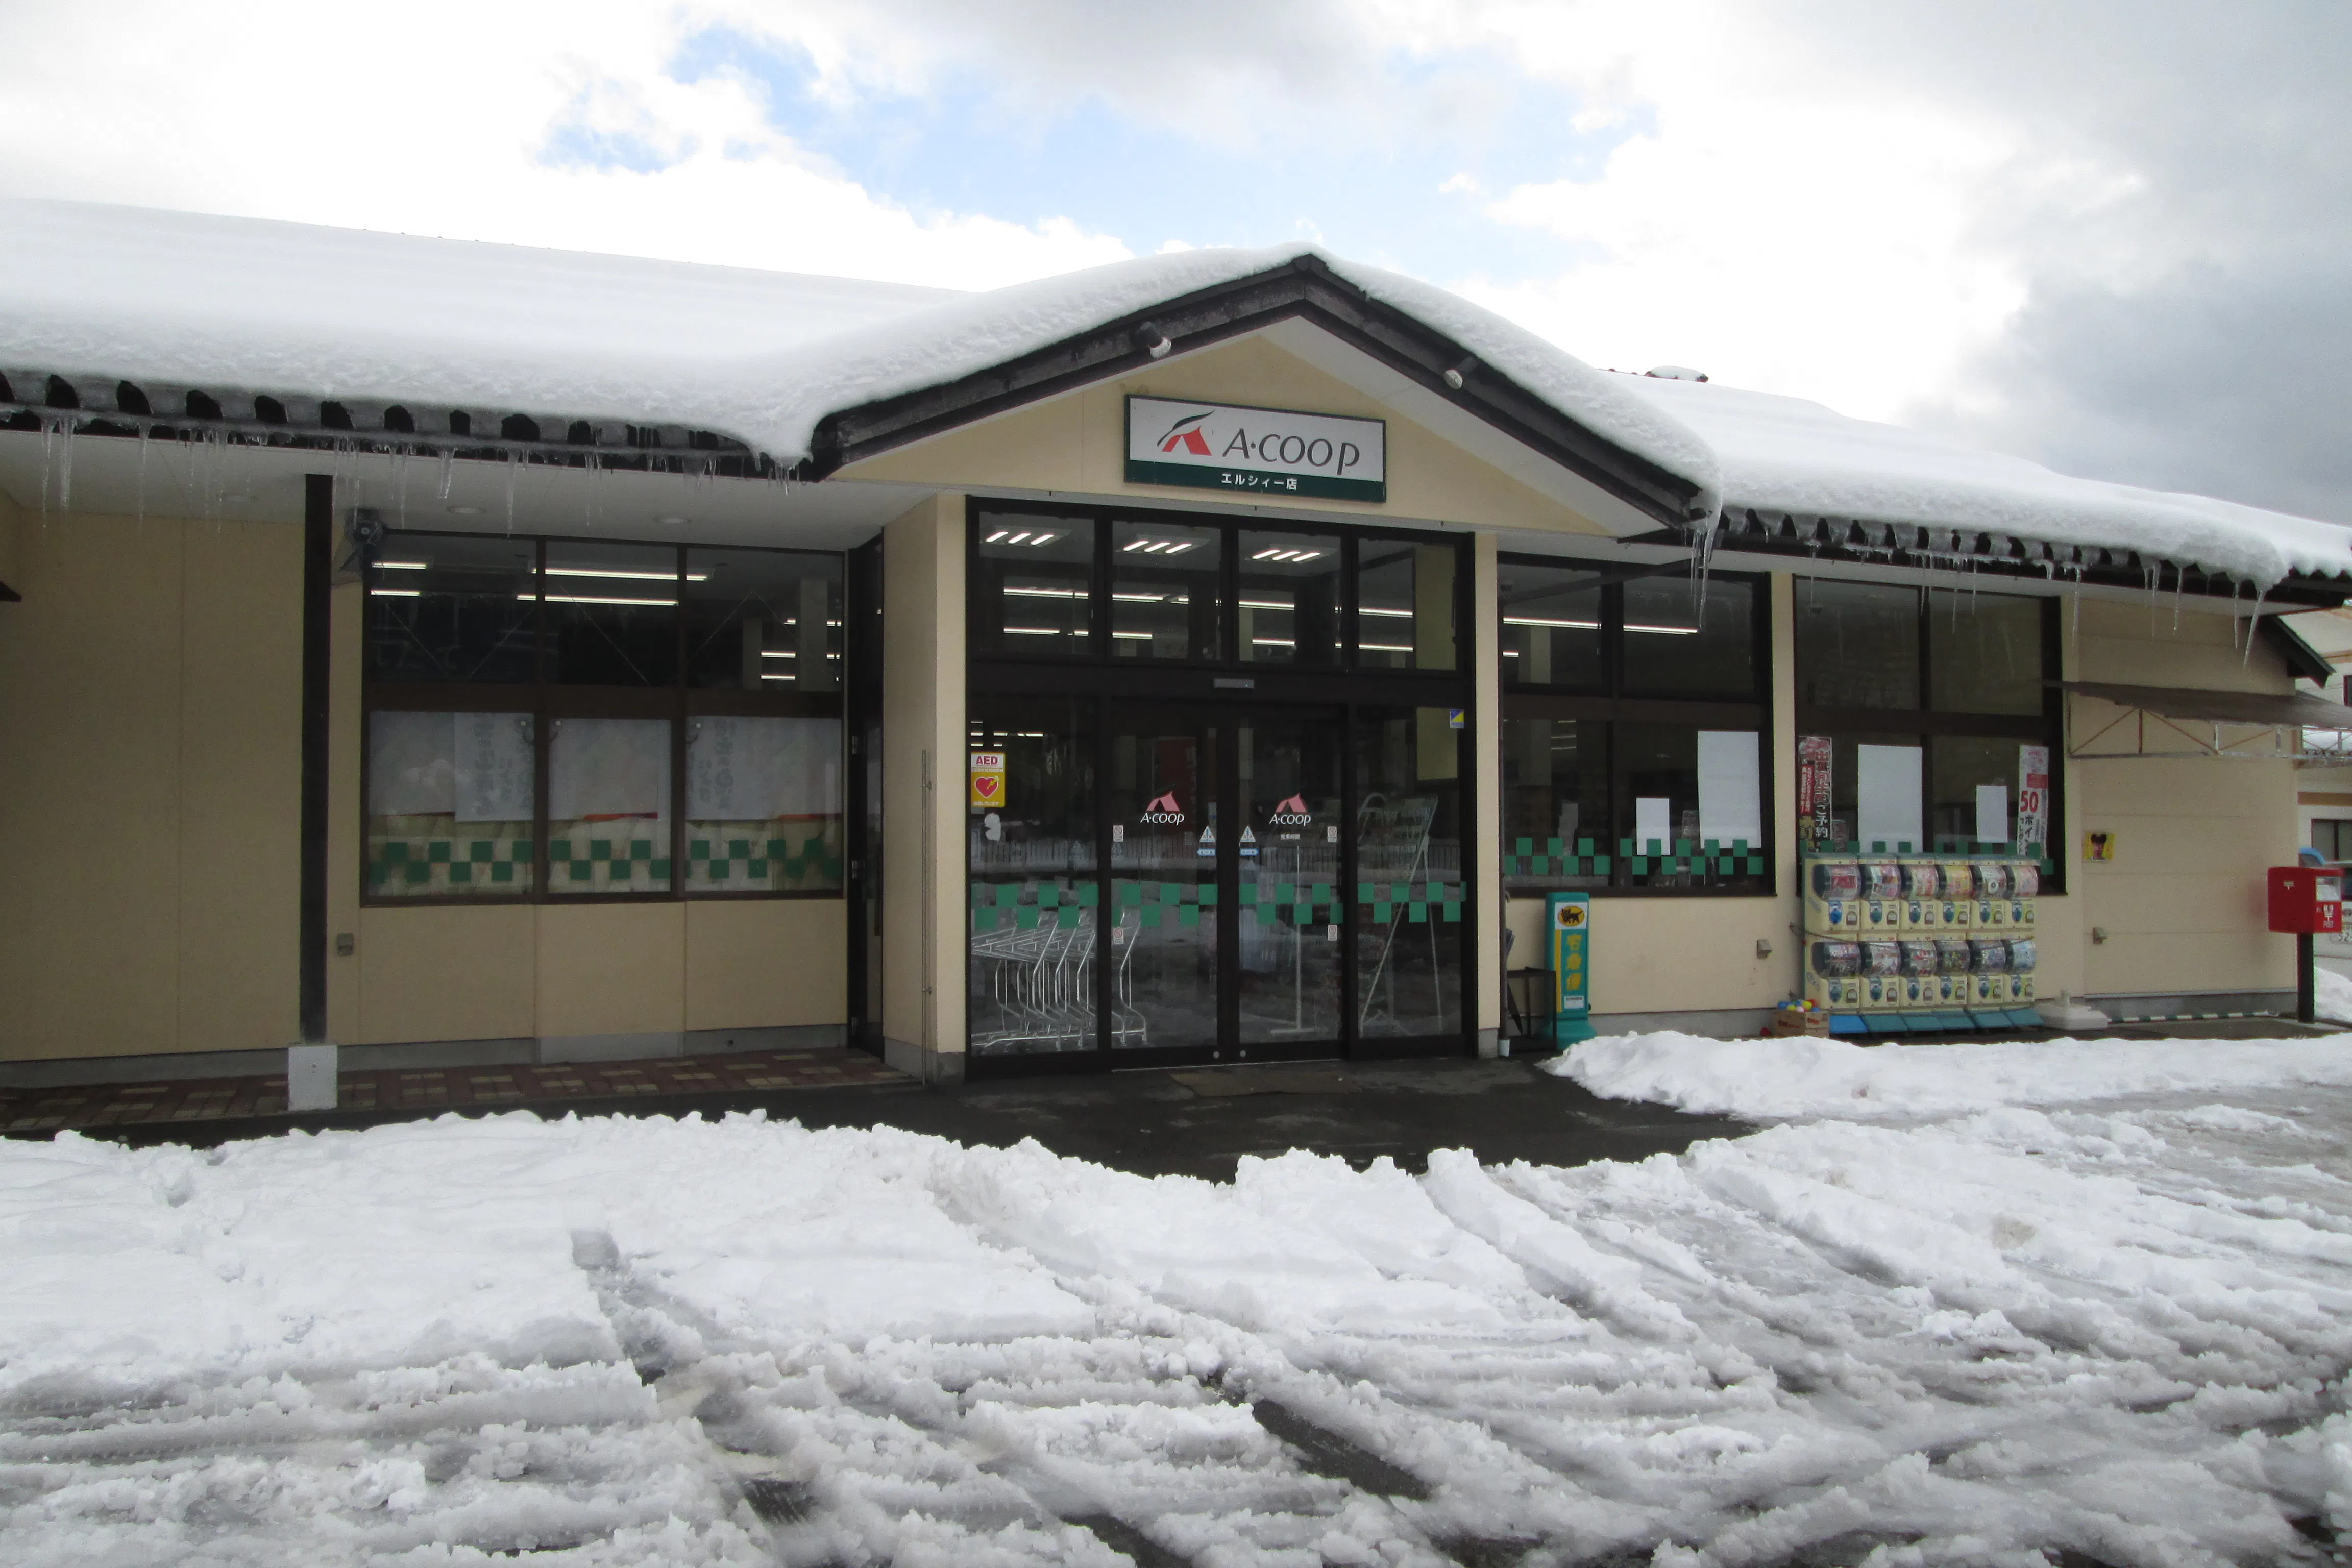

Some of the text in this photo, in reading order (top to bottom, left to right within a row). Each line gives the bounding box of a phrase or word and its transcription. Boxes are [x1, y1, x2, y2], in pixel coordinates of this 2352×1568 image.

[1221, 473, 1297, 491] エルシィー店
[976, 756, 998, 765] AED
[2020, 791, 2038, 813] 50
